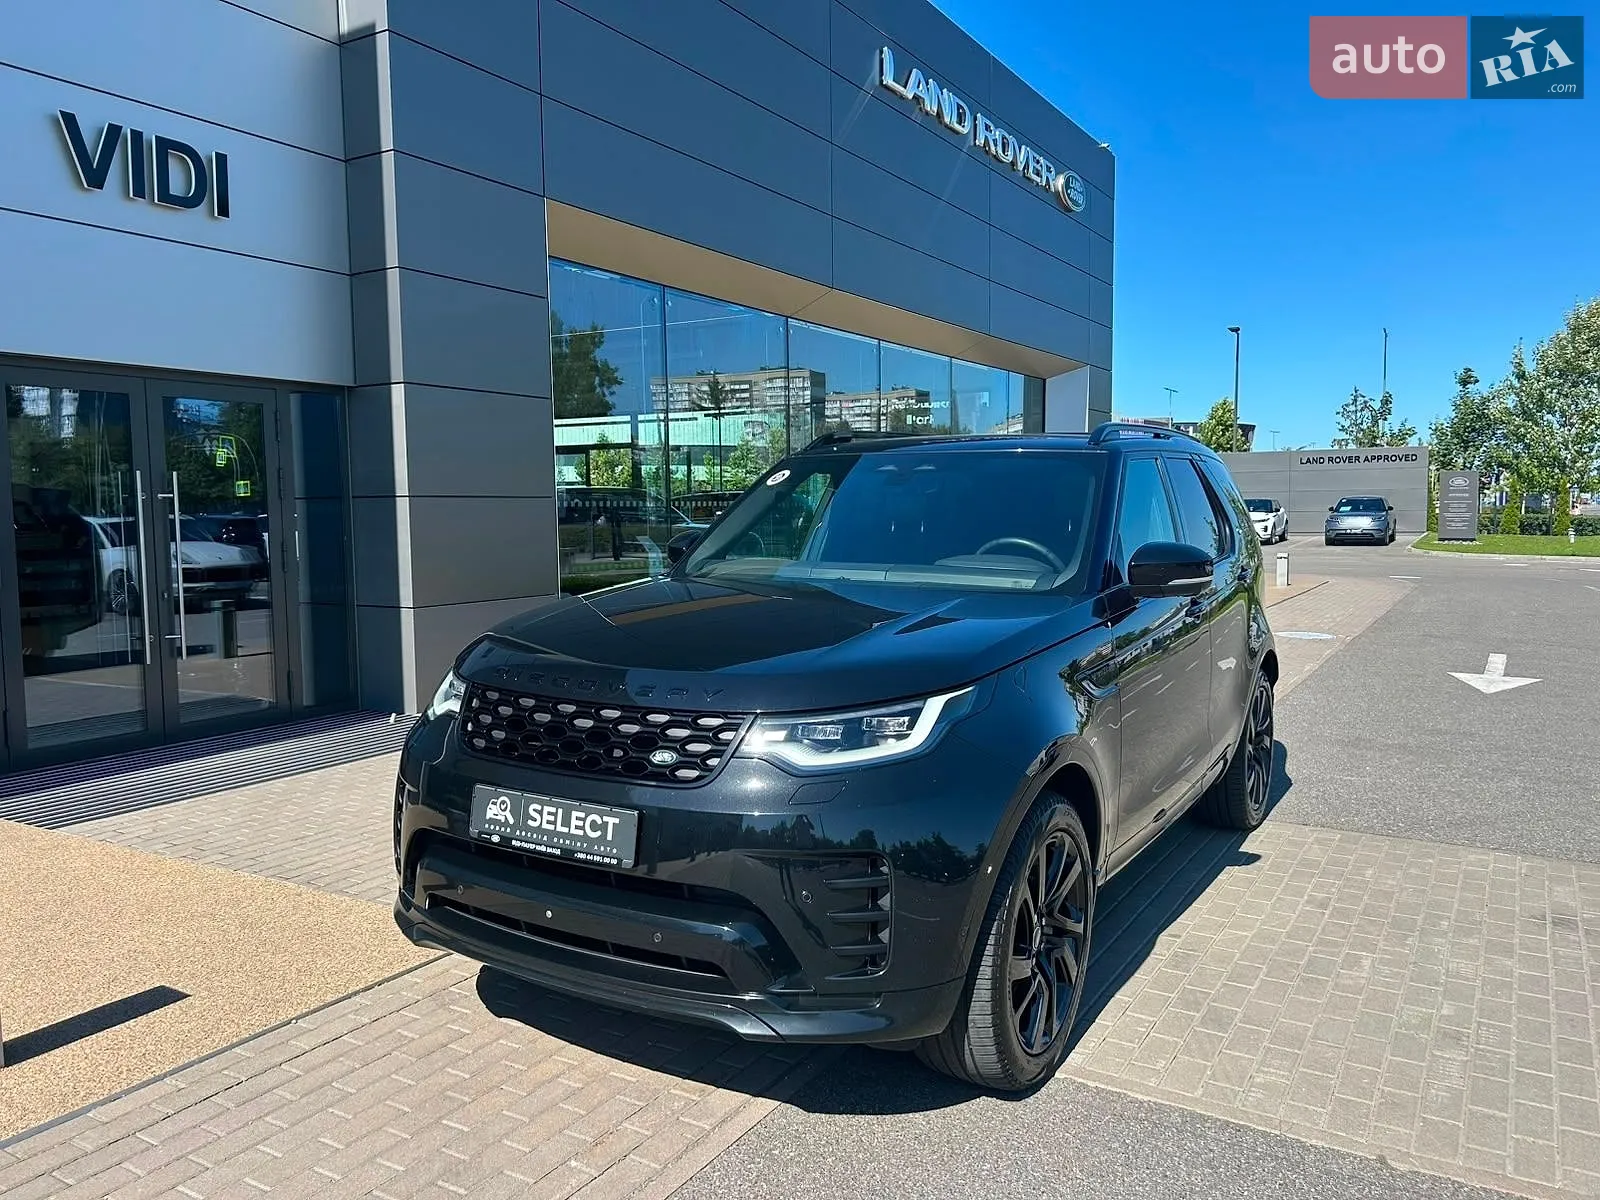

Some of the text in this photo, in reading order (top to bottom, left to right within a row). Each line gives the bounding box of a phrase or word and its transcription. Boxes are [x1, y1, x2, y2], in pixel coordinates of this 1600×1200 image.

[881, 46, 1056, 192] LAND ROVER
[57, 109, 230, 220] VIDI
[1299, 453, 1418, 465] LAND ROVER APPROVED
[527, 803, 620, 841] SELECT
